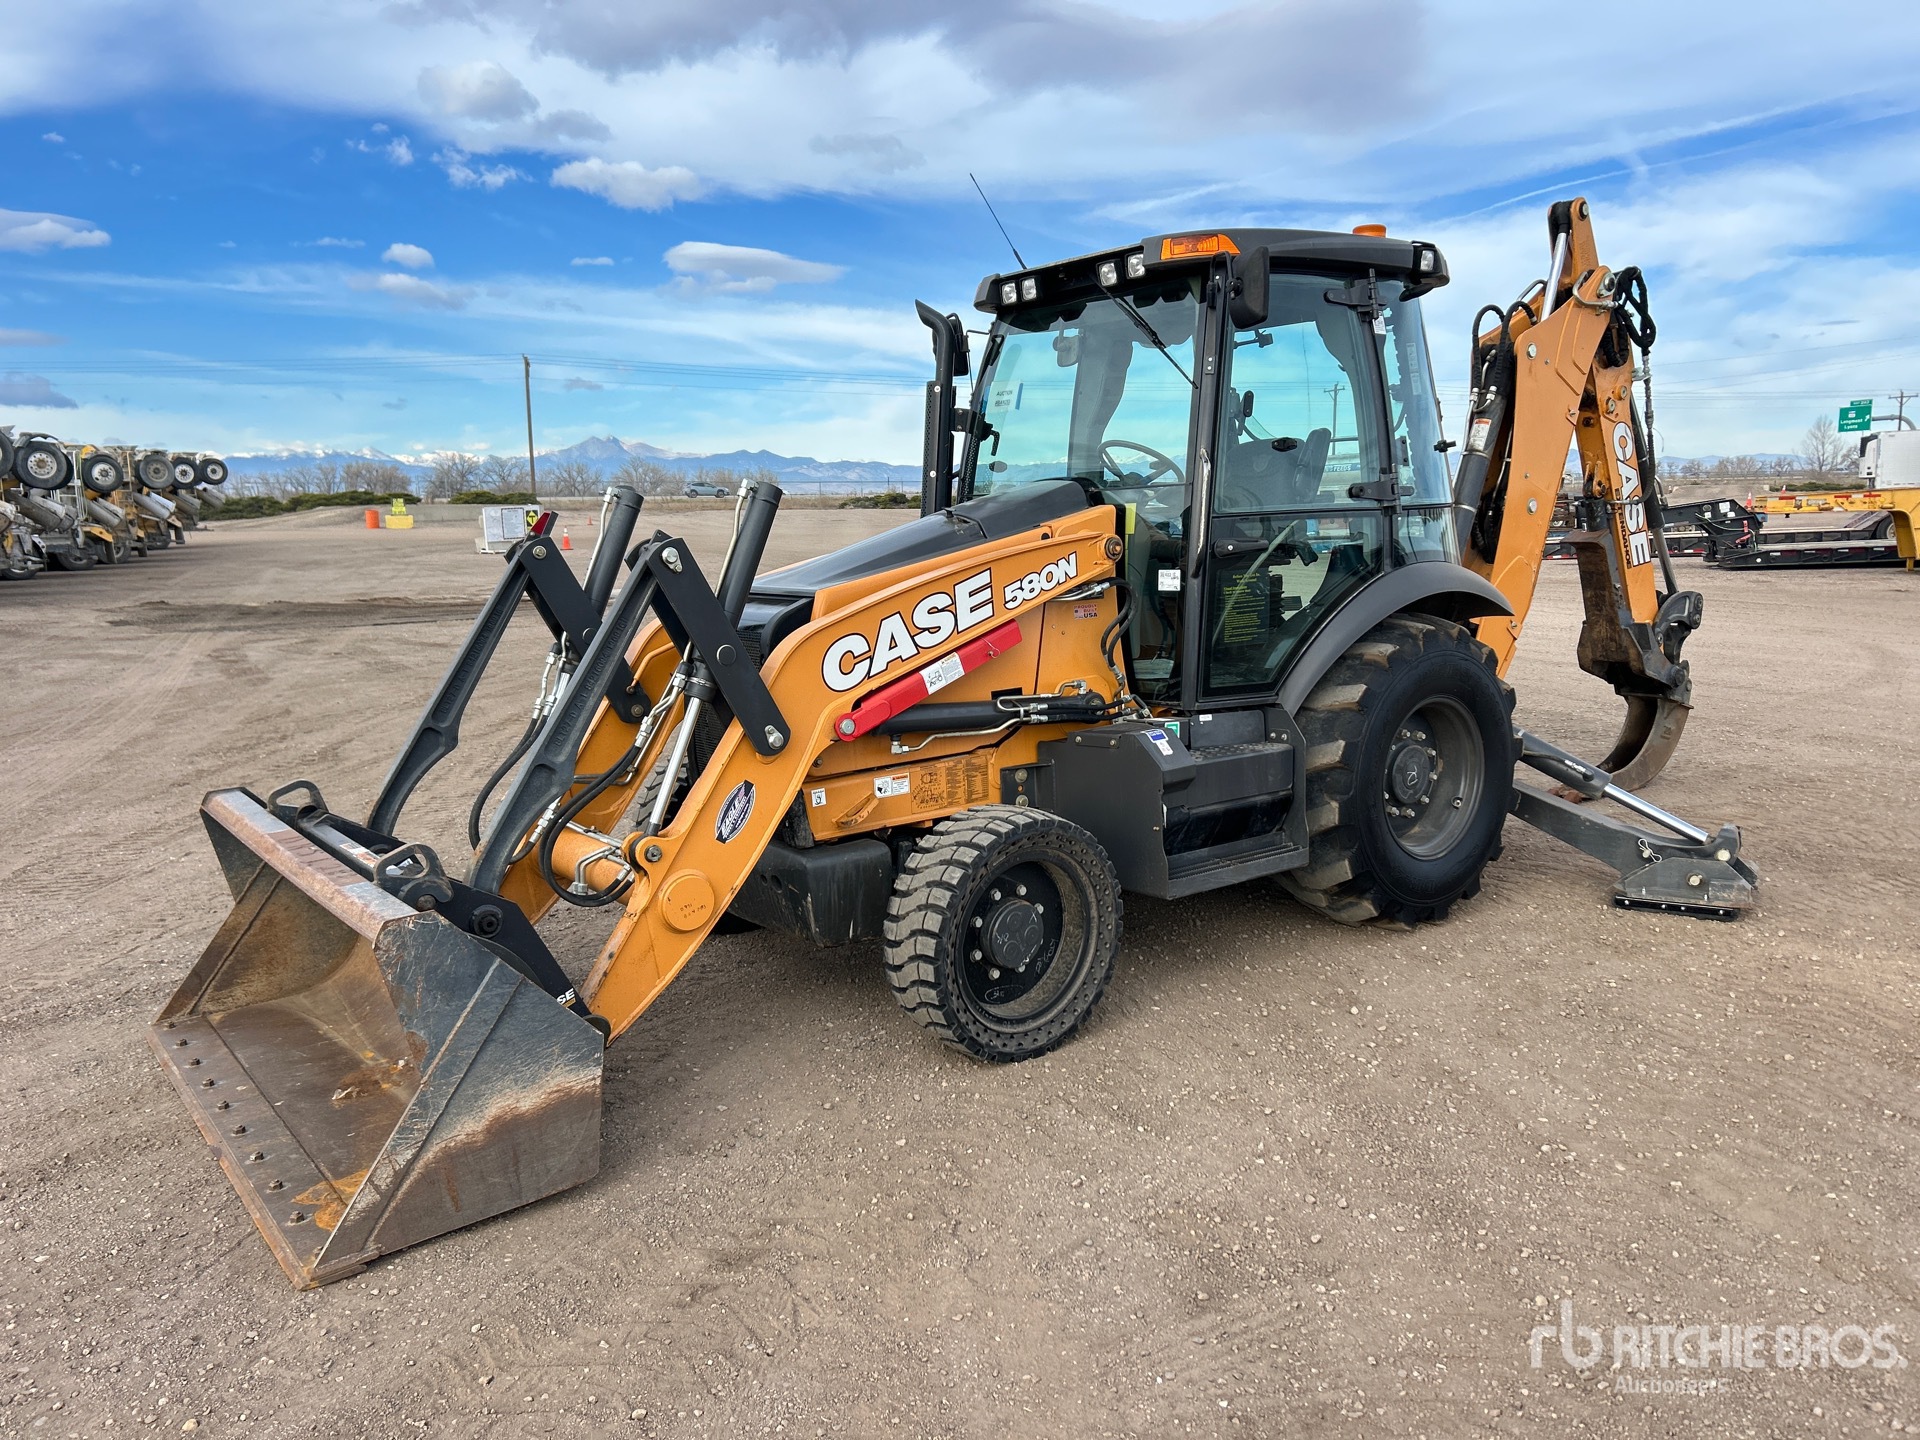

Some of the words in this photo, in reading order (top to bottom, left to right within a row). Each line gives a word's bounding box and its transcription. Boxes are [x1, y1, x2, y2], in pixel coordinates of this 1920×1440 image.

[1612, 421, 1652, 568] CASE
[821, 567, 995, 692] CASE
[1003, 551, 1078, 610] 580N
